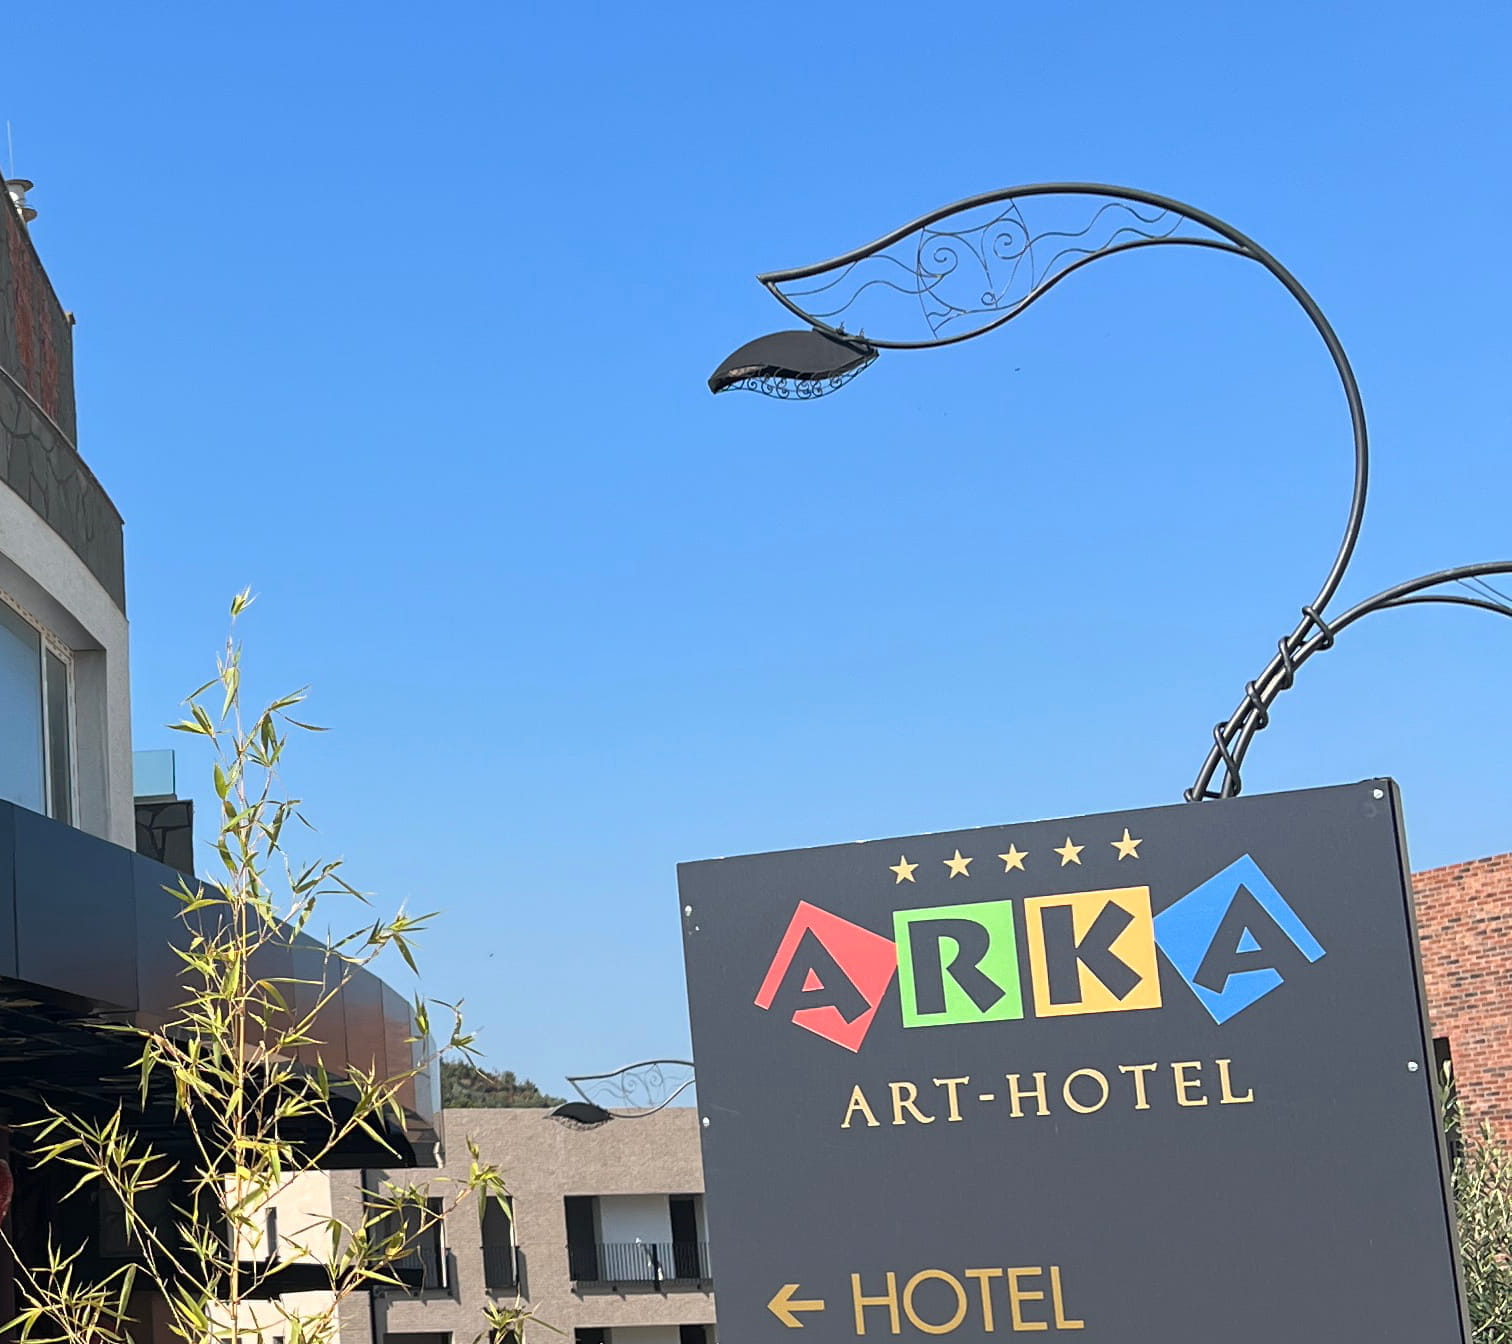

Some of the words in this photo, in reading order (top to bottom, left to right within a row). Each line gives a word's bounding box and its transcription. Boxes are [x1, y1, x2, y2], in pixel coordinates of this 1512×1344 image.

[766, 876, 1296, 1032] ARKA
[840, 1058, 1256, 1130] ART-HOTEL
[850, 1265, 1085, 1336] HOTEL
